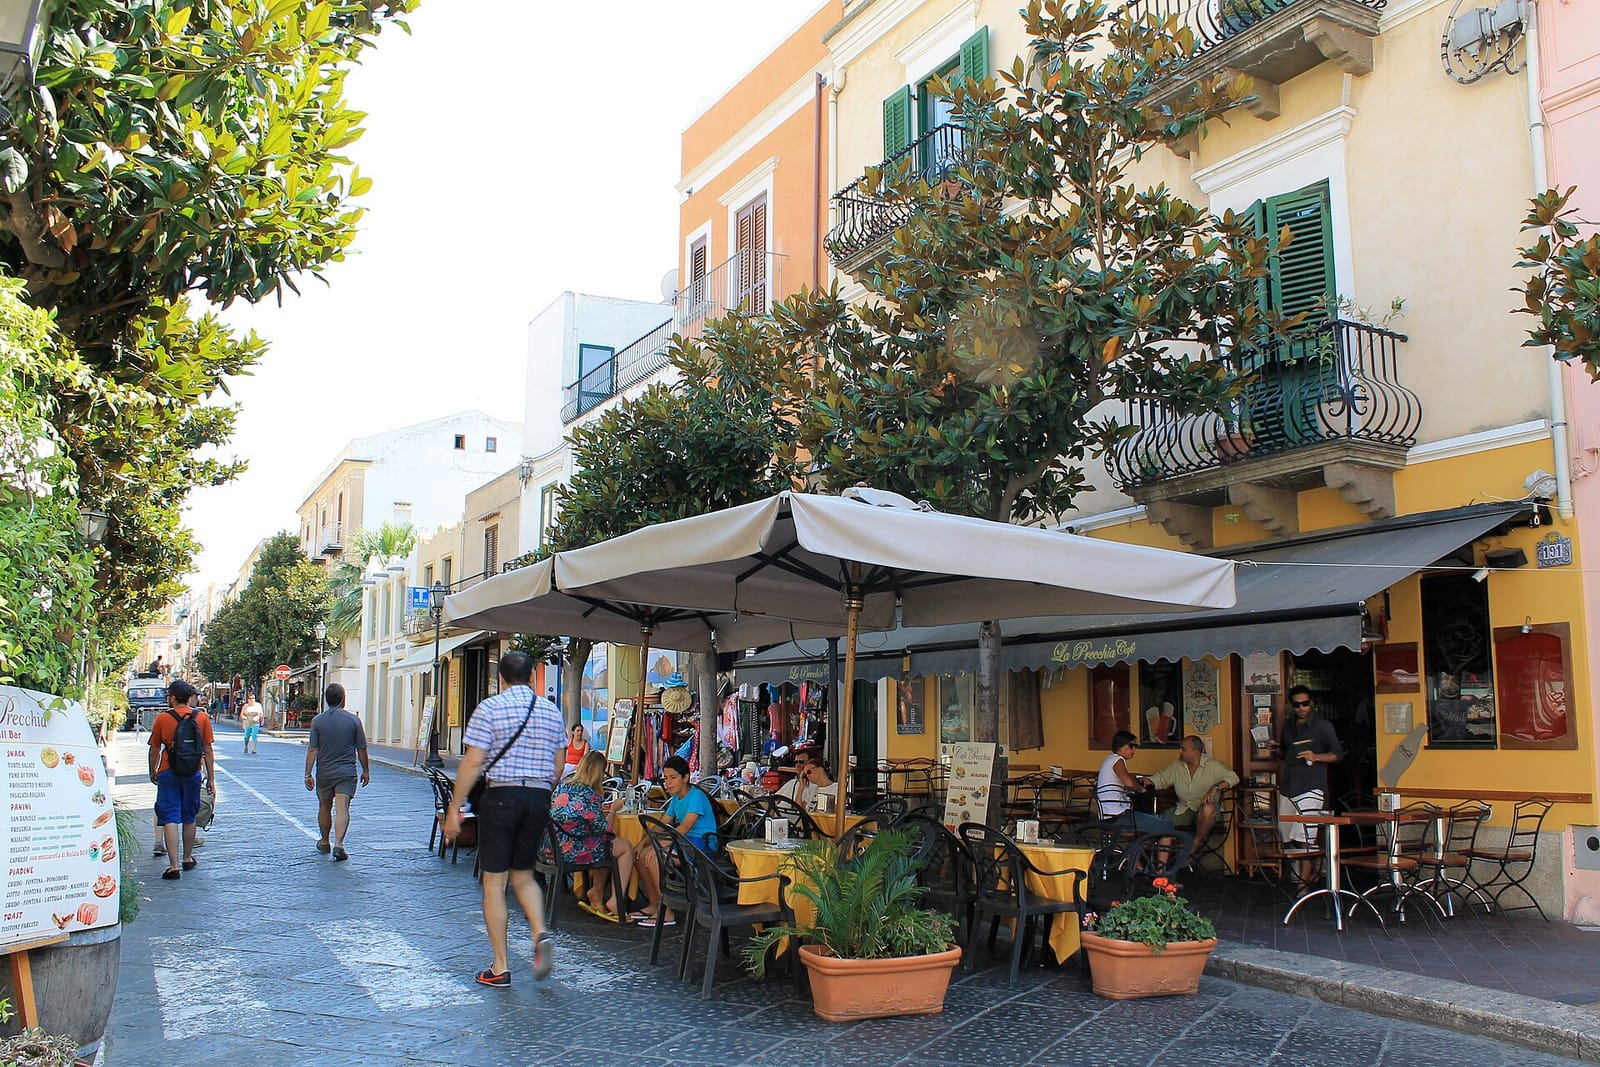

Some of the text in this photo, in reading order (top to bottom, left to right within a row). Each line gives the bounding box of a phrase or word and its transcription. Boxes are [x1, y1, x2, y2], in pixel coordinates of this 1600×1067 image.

[1543, 543, 1562, 559] 191
[1072, 641, 1116, 660] Precchia
[0, 694, 48, 727] Precchia
[9, 729, 21, 739] Bar
[6, 750, 26, 758] SNACK
[10, 803, 32, 811] PANINI
[8, 866, 34, 876] PIADINE
[7, 874, 69, 888] CRUDO FONTINA POMODORO
[23, 888, 41, 896] FONTINA
[44, 884, 67, 893] POMODORO
[5, 900, 21, 908] CRUDO
[22, 898, 41, 906] FONTINA
[65, 891, 87, 900] POMODORO
[3, 911, 23, 921] TOAST
